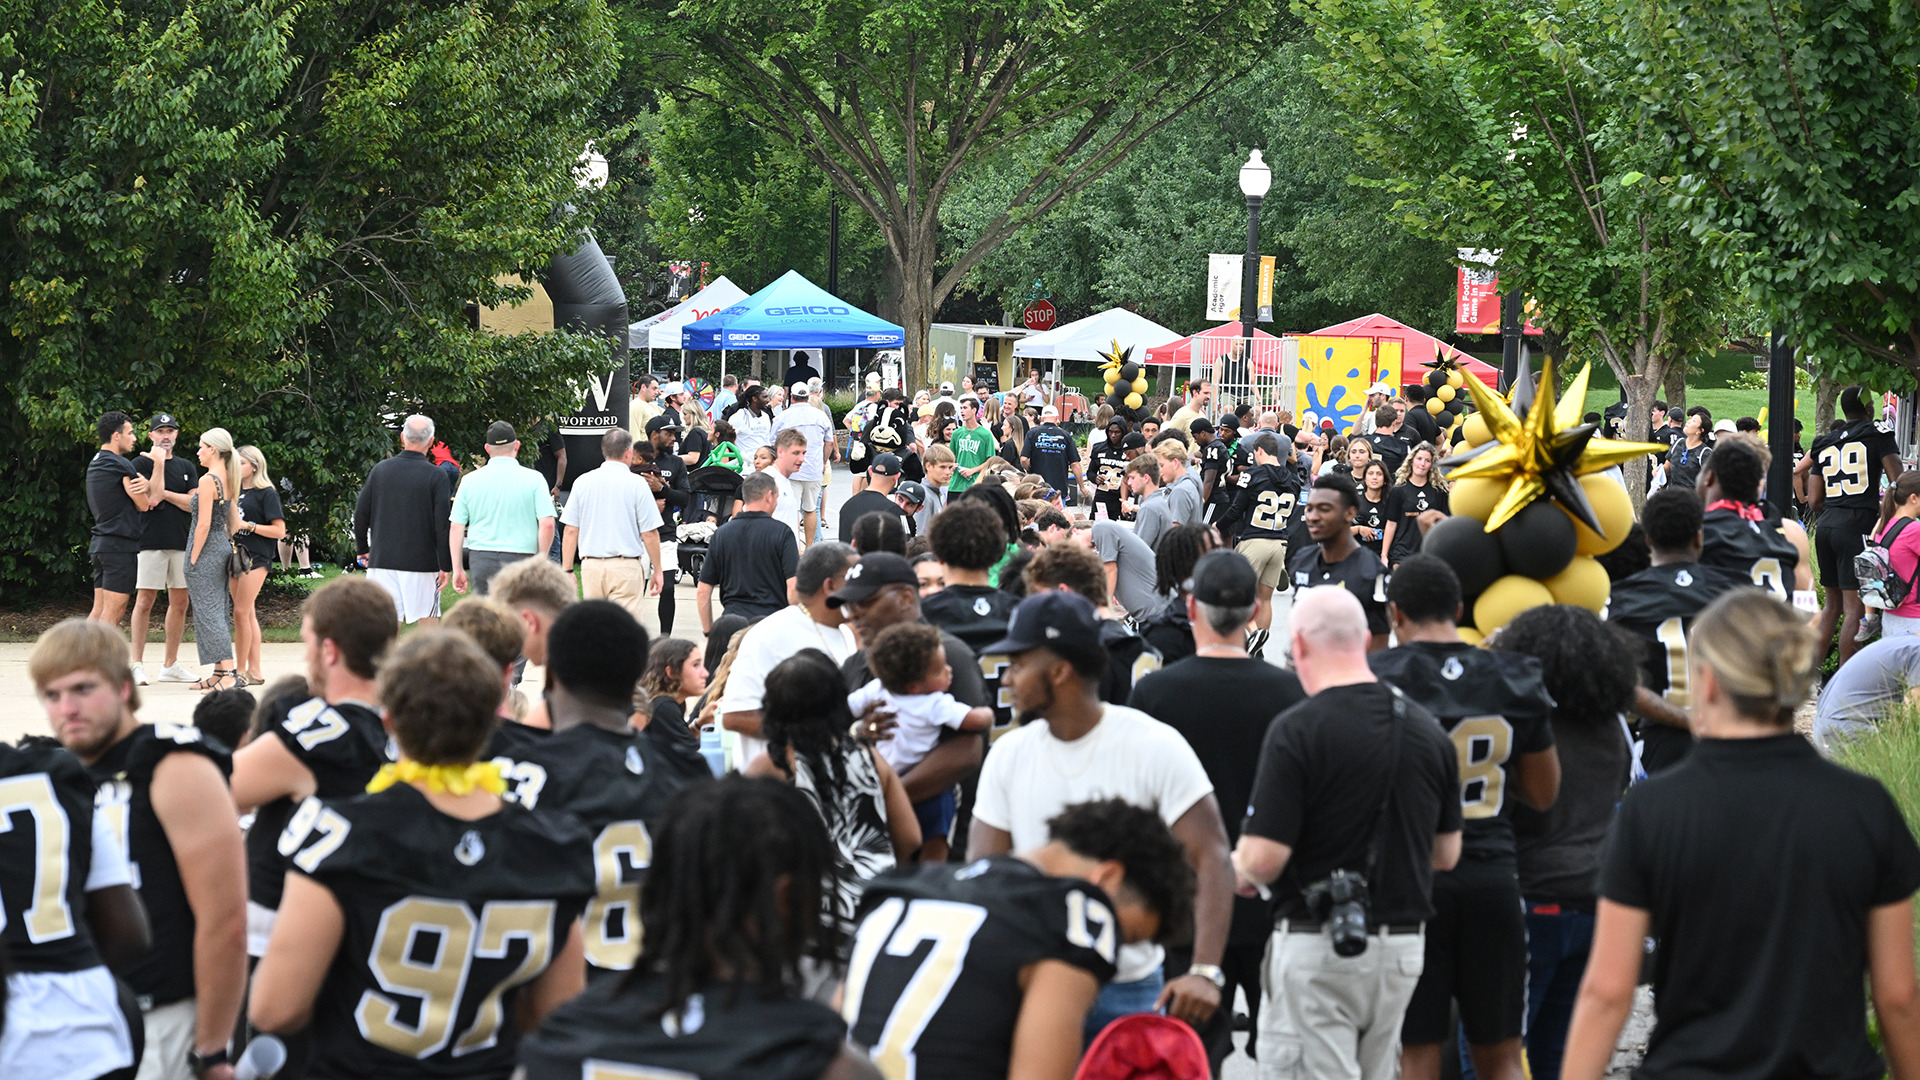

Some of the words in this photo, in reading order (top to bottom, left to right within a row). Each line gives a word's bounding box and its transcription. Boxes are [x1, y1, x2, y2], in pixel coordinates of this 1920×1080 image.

[1262, 264, 1270, 303] CELEBRATE
[1462, 265, 1470, 301] Footbal
[764, 306, 850, 316] GEICO
[1026, 309, 1053, 323] STOP
[1461, 303, 1469, 323] First
[1470, 298, 1478, 323] Game
[559, 415, 618, 426] WOFFORD
[1206, 447, 1218, 460] 14
[1818, 441, 1869, 497] 29
[1250, 490, 1296, 531] 22
[281, 696, 350, 752] 47
[277, 795, 353, 874] 97
[1065, 889, 1117, 964] 17
[354, 896, 557, 1060] 97
[841, 897, 989, 1080] 17
